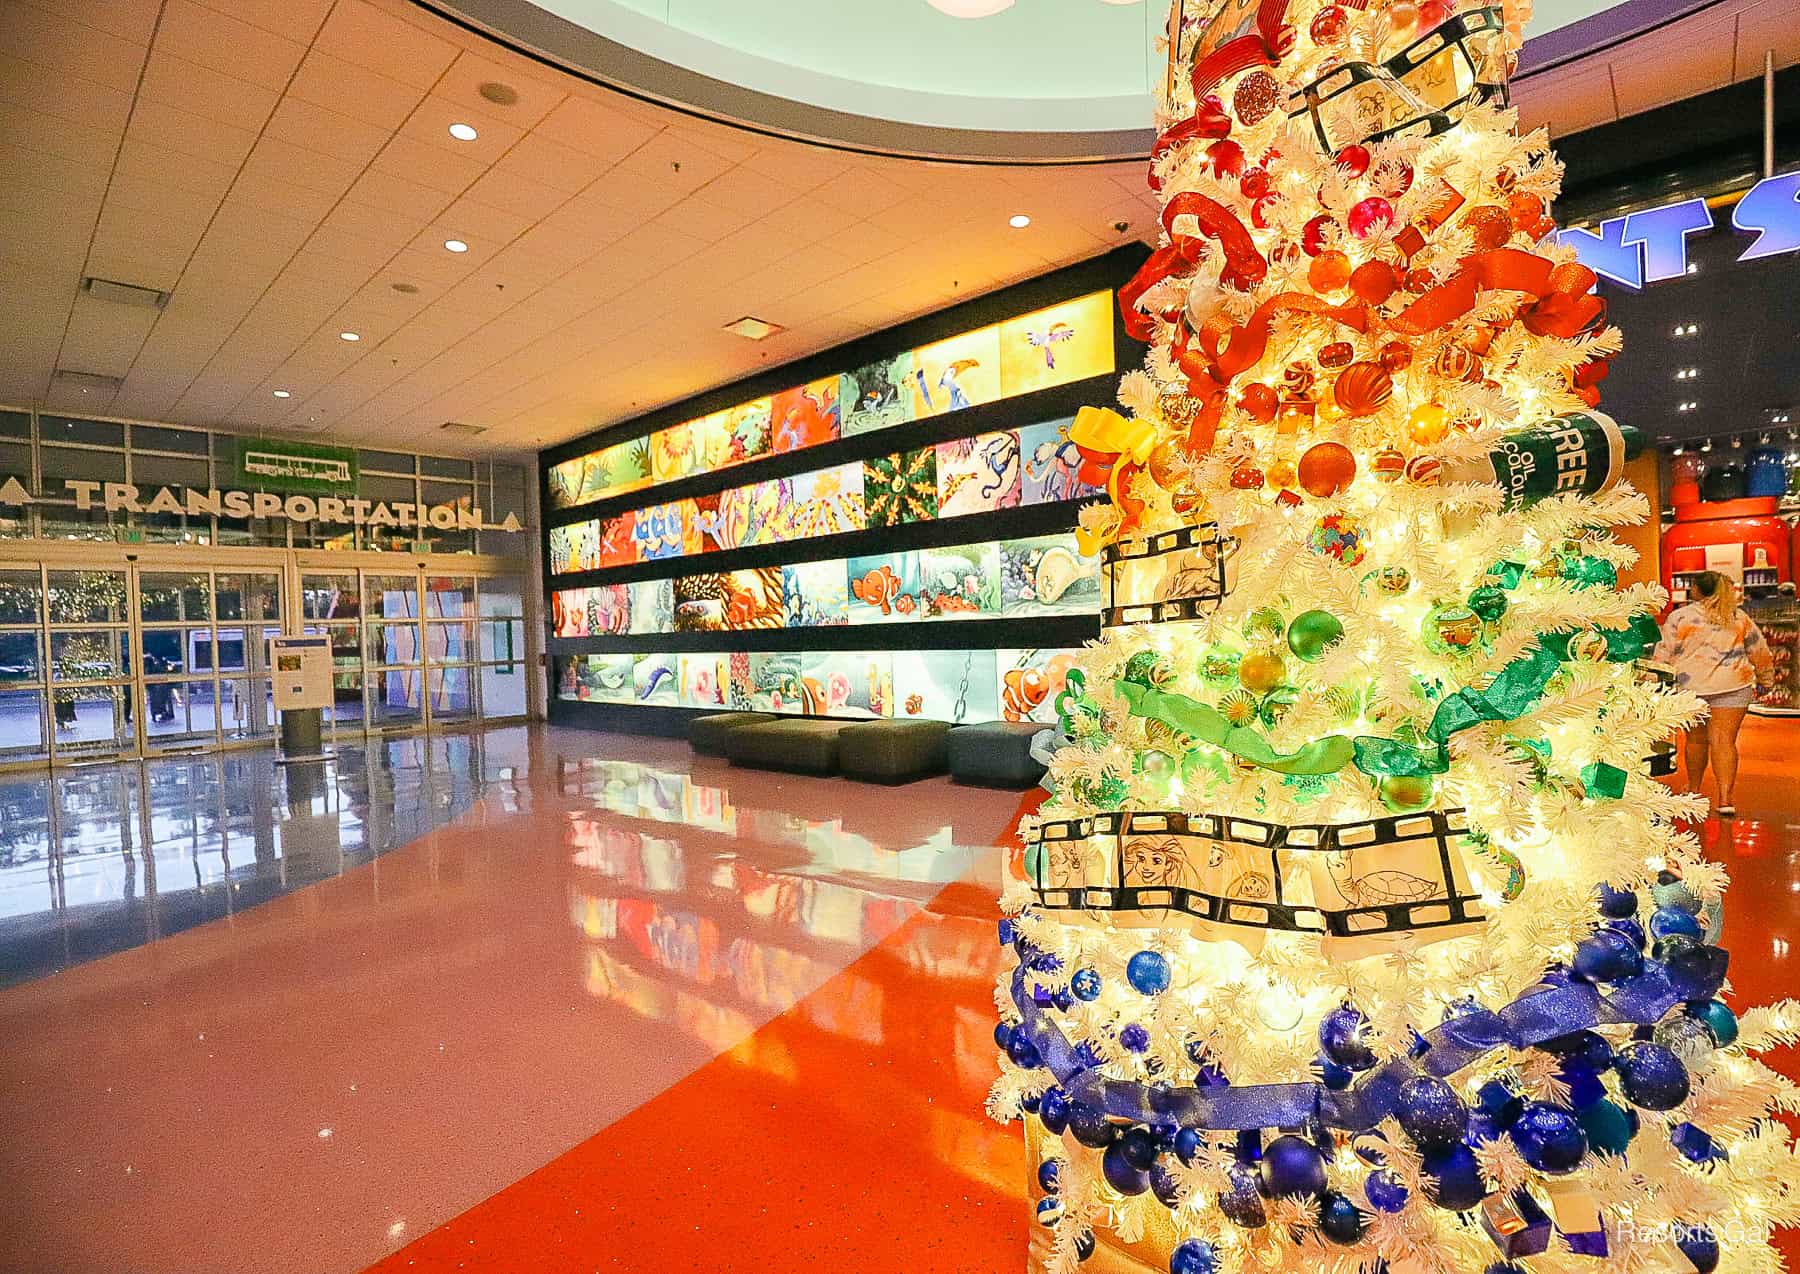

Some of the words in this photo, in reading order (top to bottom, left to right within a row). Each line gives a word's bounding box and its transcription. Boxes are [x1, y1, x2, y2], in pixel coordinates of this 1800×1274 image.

[1536, 197, 1714, 295] NT
[1503, 441, 1525, 514] COLOUR
[1520, 451, 1536, 481] OIL
[1535, 417, 1588, 498] GREE
[64, 479, 482, 532] TRANSPORTATION
